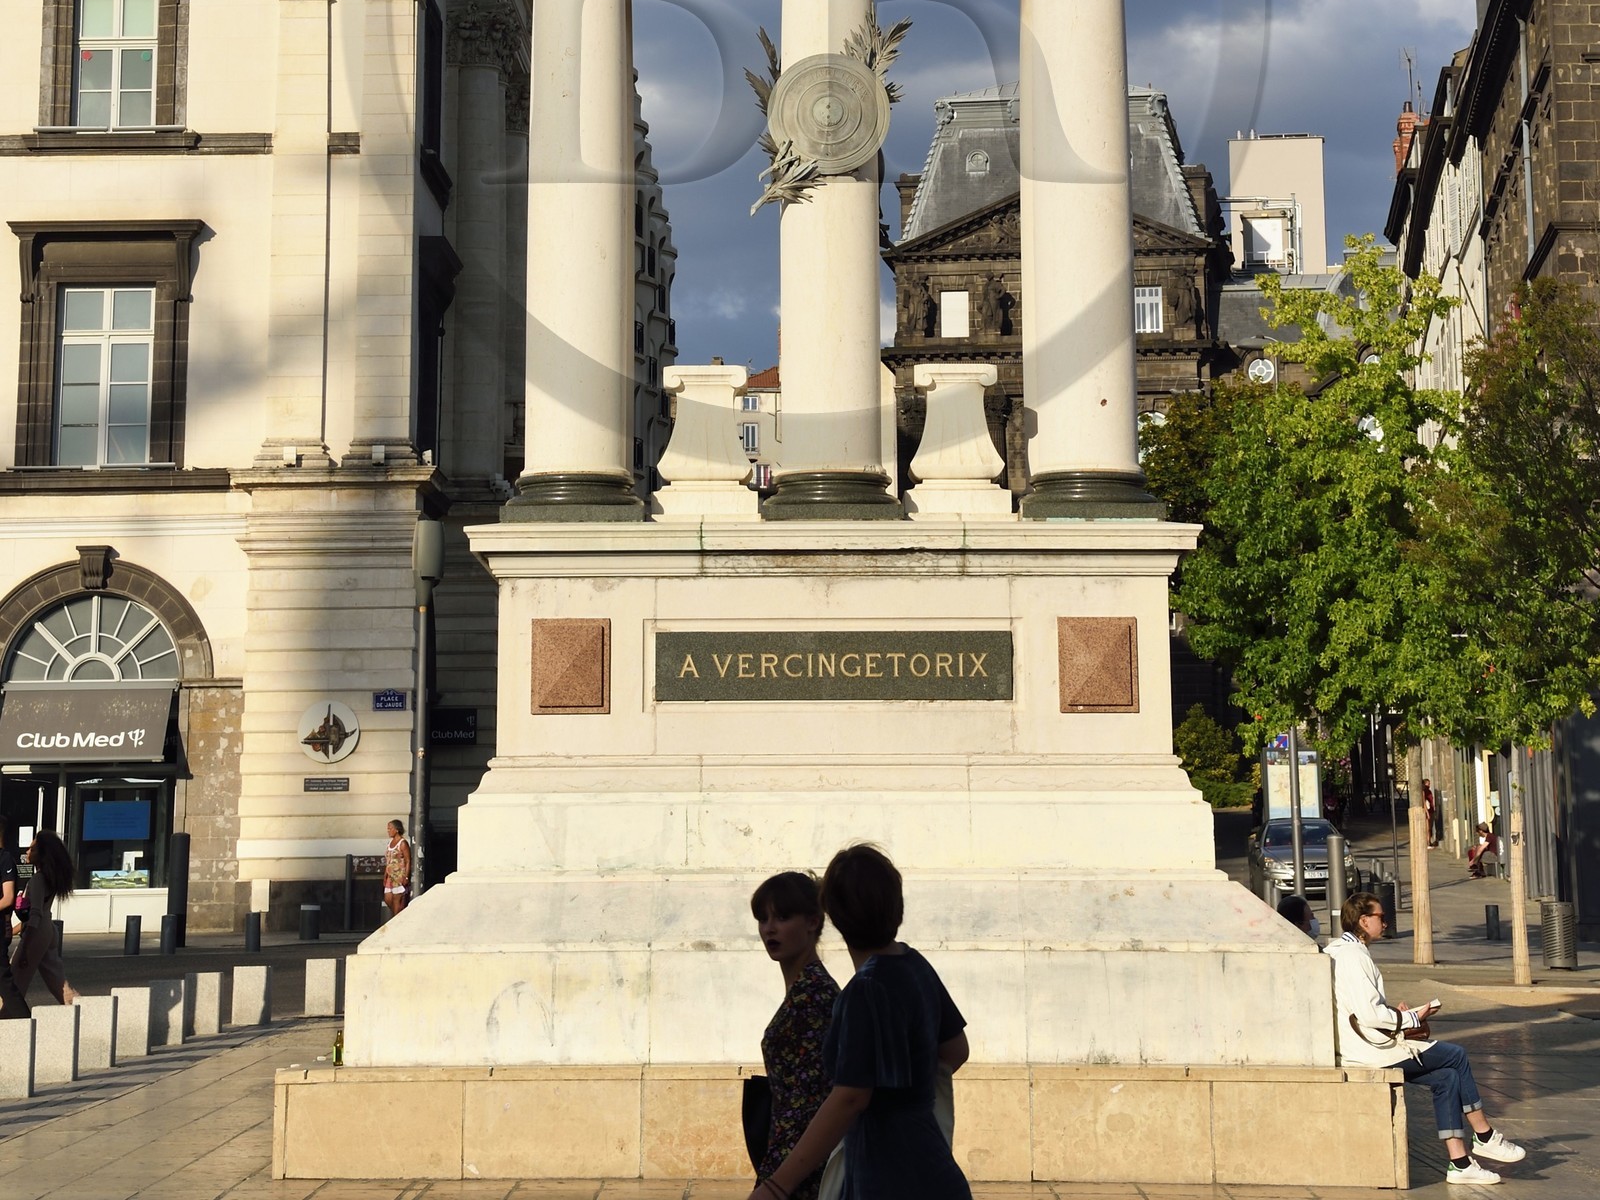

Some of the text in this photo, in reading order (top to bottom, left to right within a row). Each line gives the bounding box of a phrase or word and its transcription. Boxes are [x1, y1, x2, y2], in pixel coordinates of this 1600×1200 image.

[677, 652, 988, 679] A VERCINGETORIX
[16, 731, 125, 749] Club Med
[431, 730, 475, 739] Club Med
